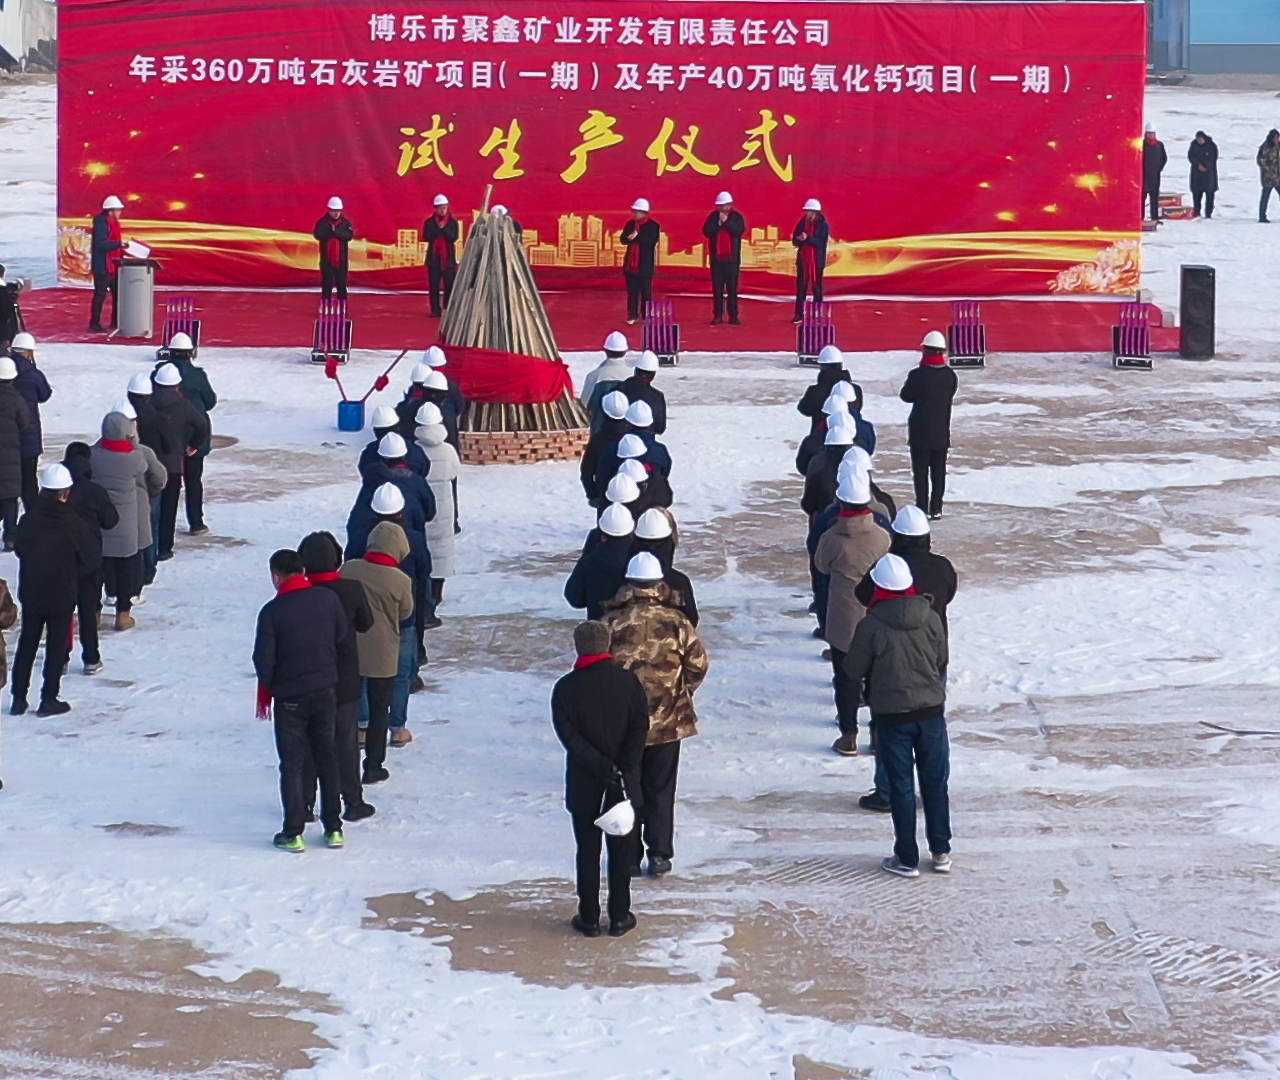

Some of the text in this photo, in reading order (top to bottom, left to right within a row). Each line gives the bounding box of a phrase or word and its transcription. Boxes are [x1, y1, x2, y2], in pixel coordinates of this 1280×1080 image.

[368, 13, 831, 48] 博乐市聚鑫矿业开发有限责任公司
[396, 107, 798, 184] 试生产仪式
